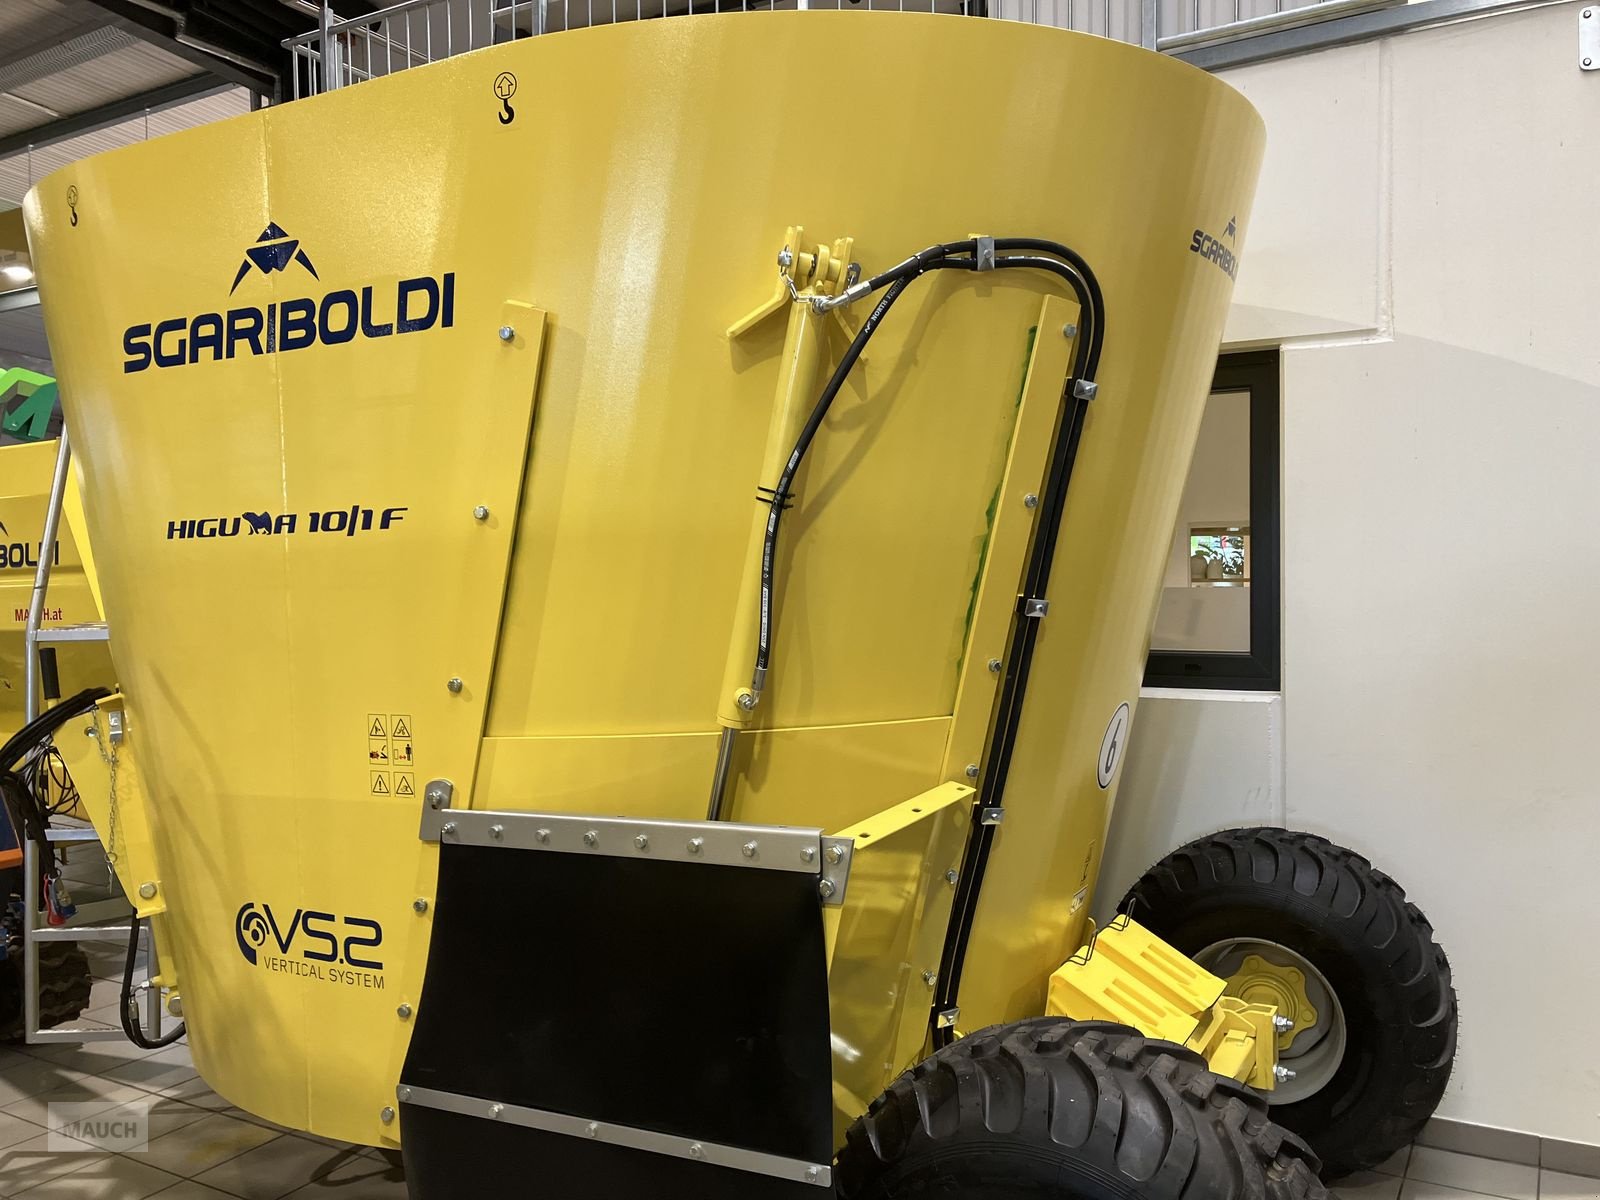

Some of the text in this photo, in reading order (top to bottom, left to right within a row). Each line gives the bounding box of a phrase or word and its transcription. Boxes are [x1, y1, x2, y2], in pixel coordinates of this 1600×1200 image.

[123, 272, 456, 374] SGARIBOLDI
[872, 298, 888, 322] NORTH
[264, 956, 385, 989] VERTICAL SYSTEM
